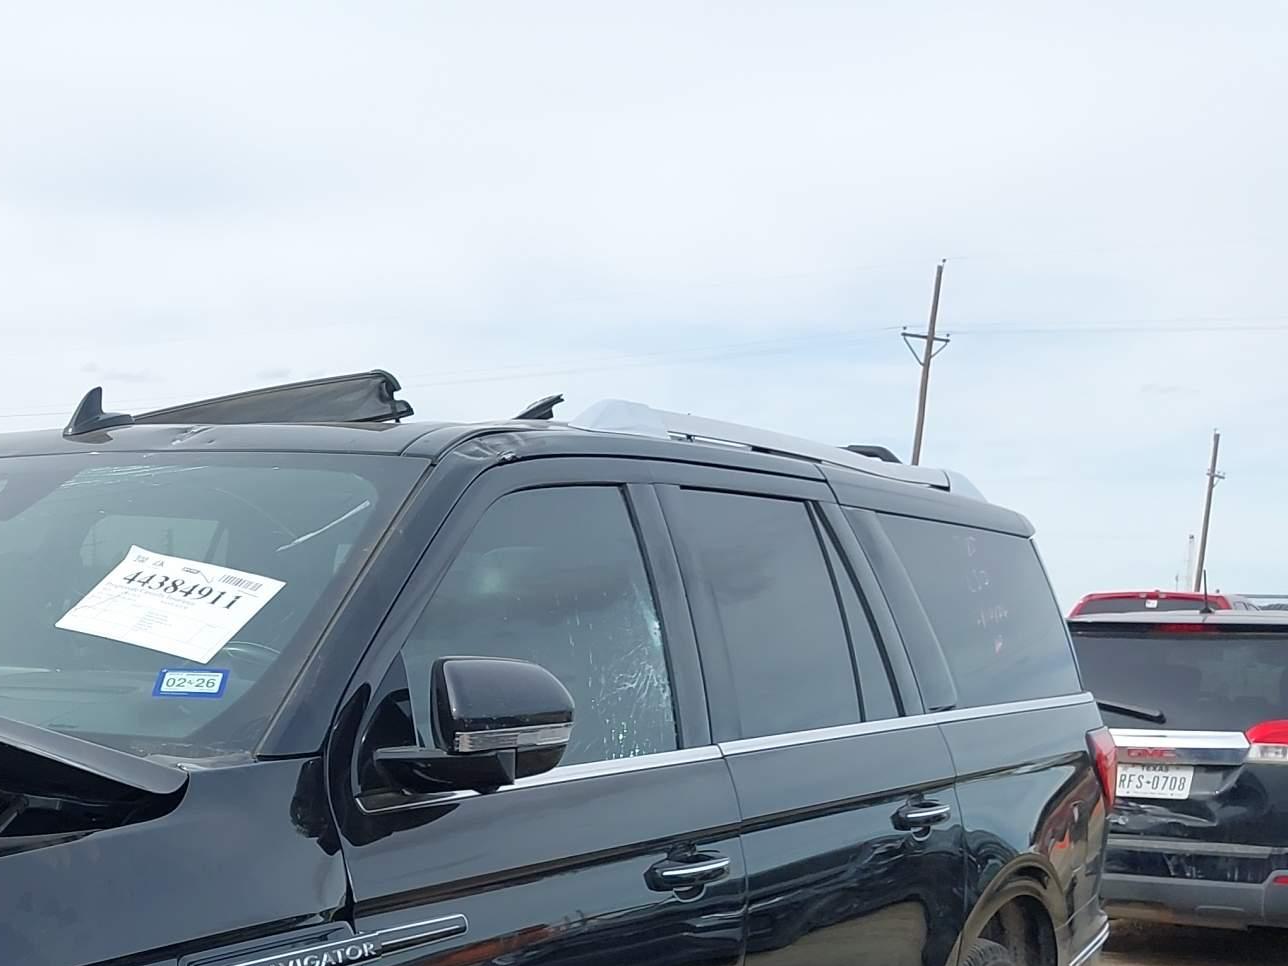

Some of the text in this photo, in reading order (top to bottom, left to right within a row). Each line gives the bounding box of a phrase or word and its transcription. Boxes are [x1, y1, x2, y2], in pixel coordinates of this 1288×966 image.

[123, 570, 243, 609] 44384911
[165, 677, 216, 688] 02 26
